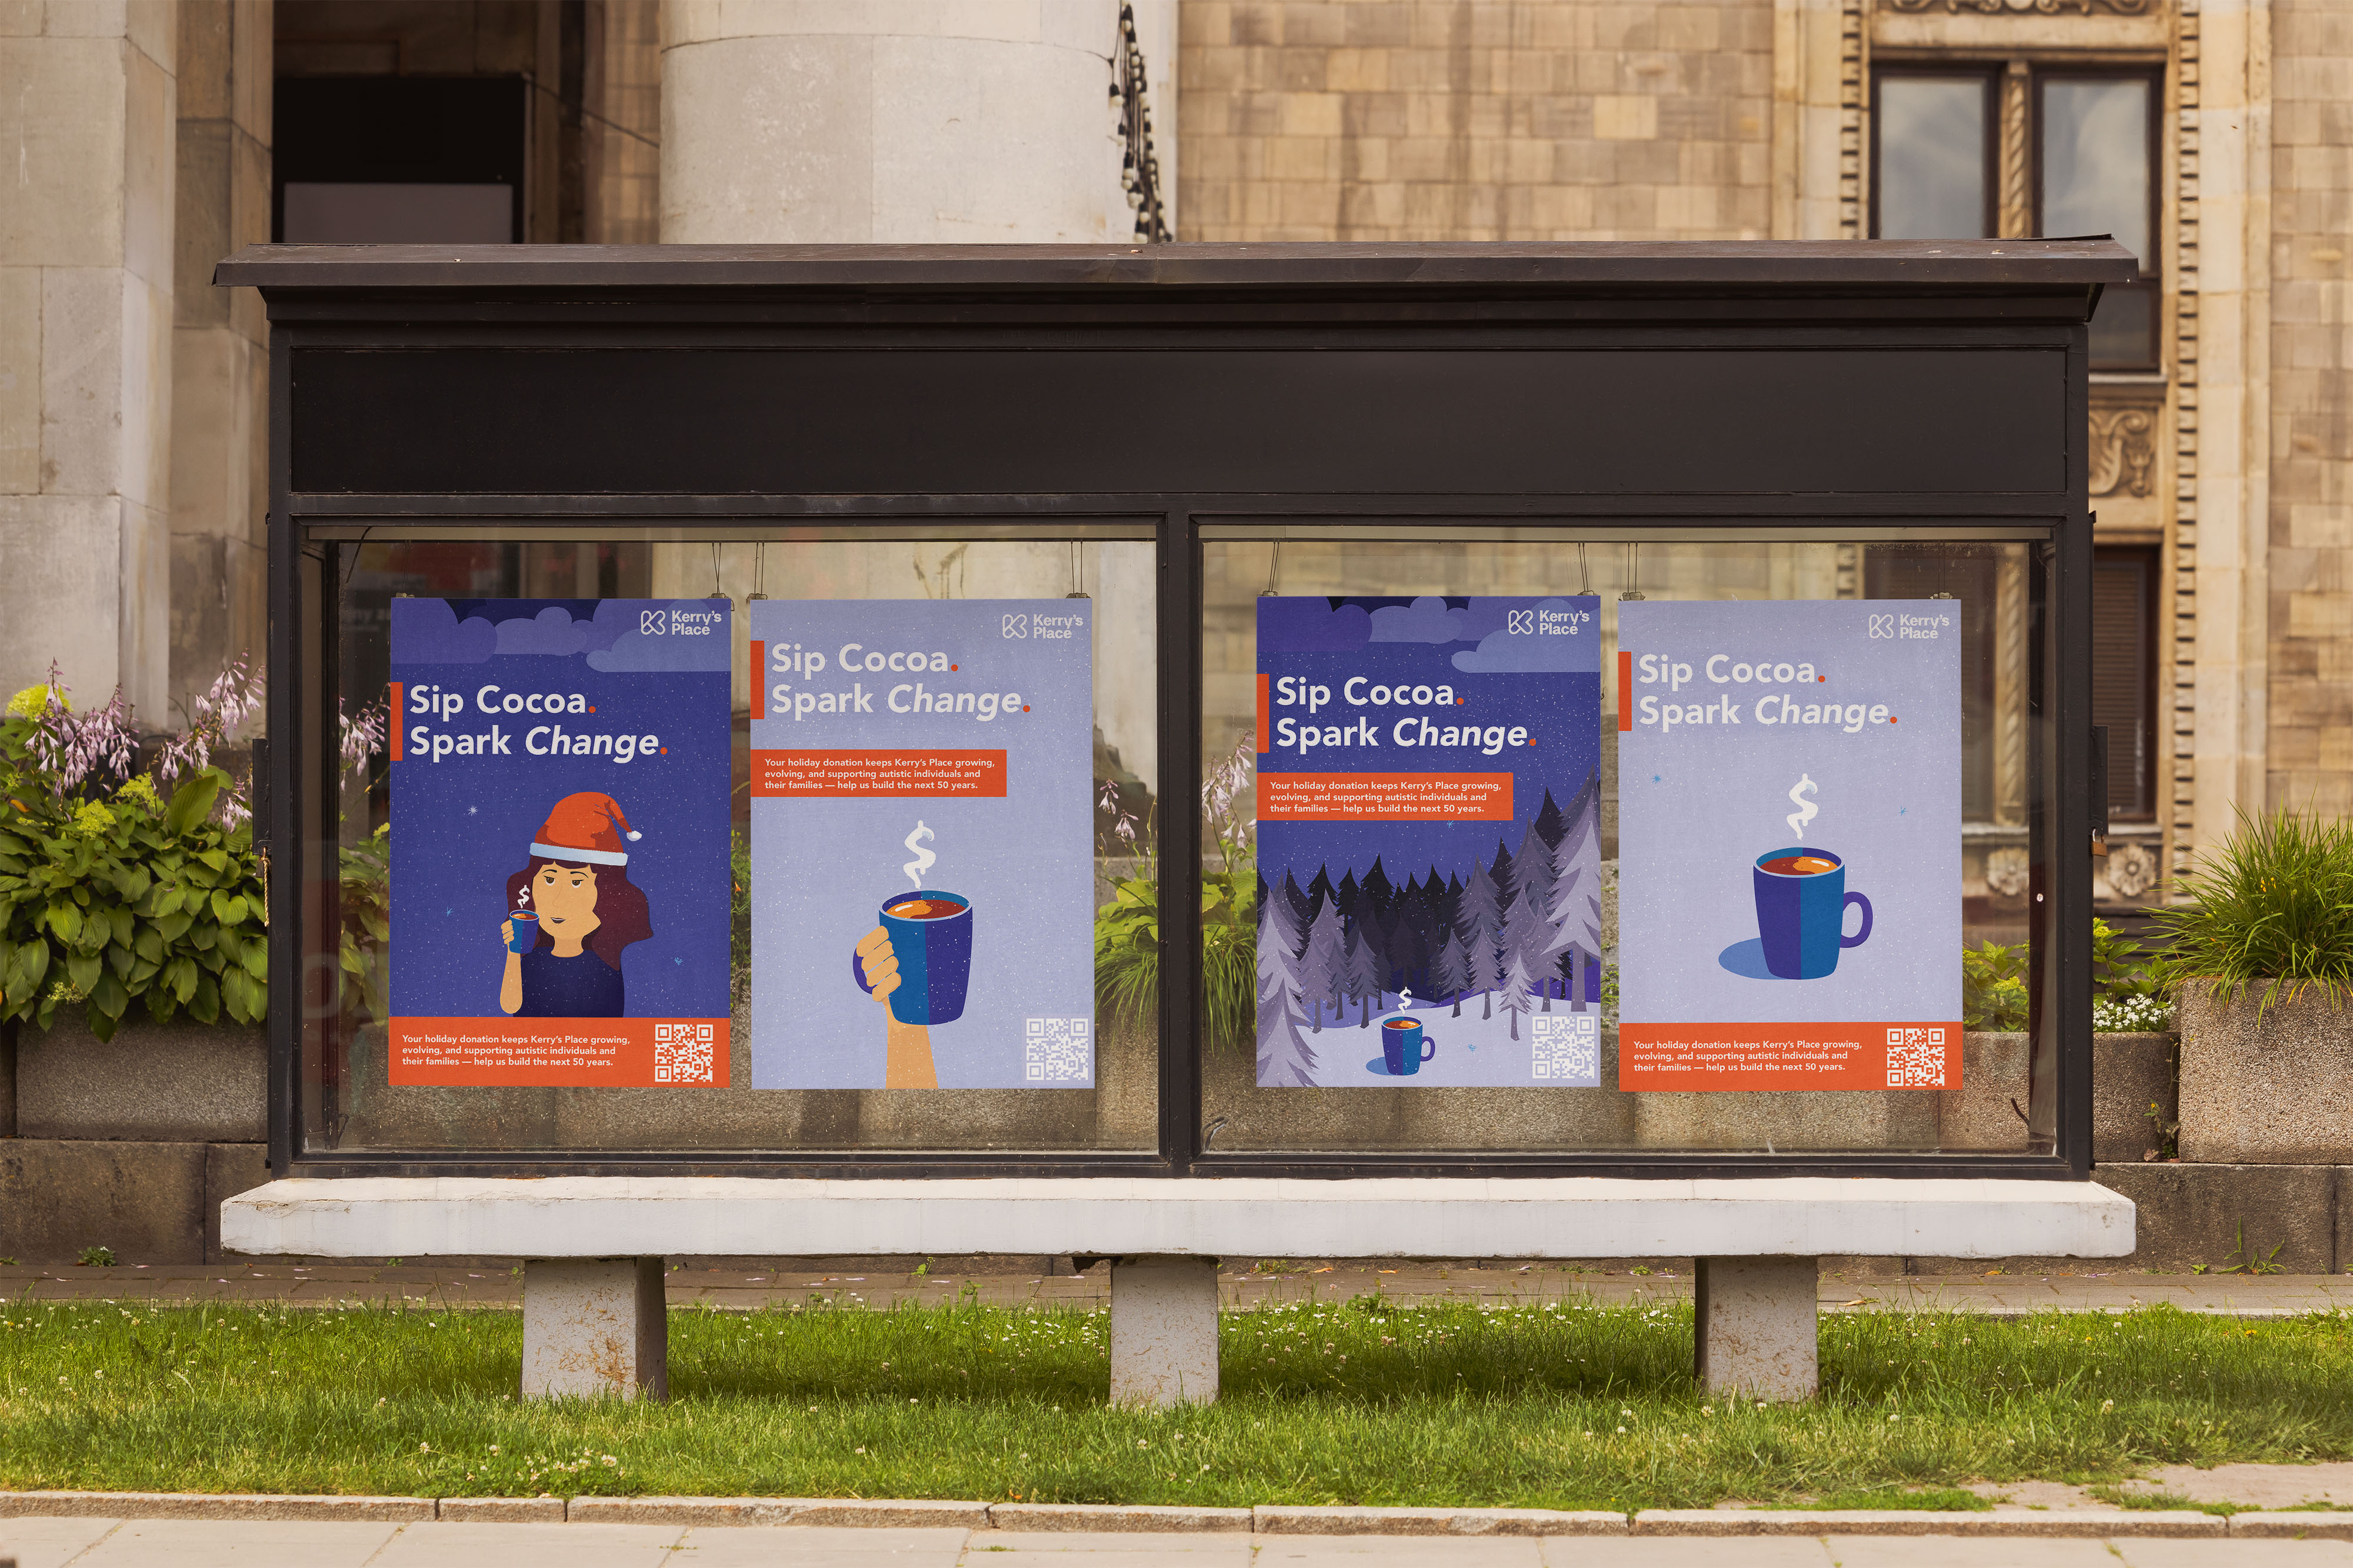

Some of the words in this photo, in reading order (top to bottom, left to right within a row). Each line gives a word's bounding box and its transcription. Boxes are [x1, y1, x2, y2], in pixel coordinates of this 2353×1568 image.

[672, 610, 722, 625] Kerry's
[1034, 614, 1084, 629] Kerry's
[1539, 610, 1589, 625] Kerry's
[1900, 614, 1949, 629] Kerry's
[672, 623, 710, 635] Place
[1034, 627, 1072, 639] Place
[1539, 623, 1578, 635] Place
[1900, 627, 1938, 639] Place
[772, 643, 825, 680] Sip
[839, 643, 958, 672] Cocoa.
[1639, 654, 1693, 692] Sip
[1706, 654, 1825, 683] Cocoa.
[1277, 676, 1331, 713] Sip
[1344, 676, 1464, 706] Cocoa.
[410, 685, 464, 722] Sip
[476, 685, 596, 714] Cocoa.
[772, 683, 874, 721] Spark
[888, 683, 1031, 722] Change.
[1639, 694, 1741, 733] Spark
[1755, 694, 1897, 733] Change.
[1277, 716, 1379, 755] Spark
[1393, 716, 1537, 755] Change.
[410, 725, 512, 763] Spark
[525, 725, 668, 763] Change.
[765, 758, 786, 766] Your
[788, 758, 821, 768] holiday
[823, 758, 863, 766] donation
[865, 758, 892, 768] keeps
[895, 758, 926, 768] Kerry's
[929, 758, 952, 766] Place
[955, 758, 995, 768] growing,
[765, 769, 805, 780] evolving,
[808, 769, 825, 778] and
[828, 770, 876, 780] supporting
[914, 769, 962, 778] individuals
[964, 769, 981, 778] and
[764, 780, 786, 789] their
[788, 780, 823, 789] families
[838, 780, 857, 791] help
[872, 780, 894, 789] build
[896, 780, 912, 789] the
[951, 783, 978, 791] years.
[1293, 781, 1326, 792] holiday
[1328, 781, 1369, 789] donation
[1371, 781, 1398, 792] keeps
[1401, 782, 1432, 792] Kerry's
[1435, 781, 1459, 789] Place
[1461, 782, 1501, 792] growing,
[1270, 792, 1311, 803] evolving,
[1314, 792, 1331, 801] and
[1333, 793, 1382, 803] supporting
[1385, 793, 1418, 801] autistic
[1420, 792, 1468, 801] individuals
[1470, 792, 1487, 801] and
[1270, 804, 1292, 812] their
[1294, 804, 1328, 812] families
[1343, 804, 1363, 815] help
[1378, 804, 1400, 812] build
[1402, 804, 1418, 812] the
[1444, 804, 1455, 812] 50
[1457, 806, 1484, 815] years.
[402, 1035, 423, 1043] Your
[425, 1034, 458, 1045] holiday
[459, 1035, 499, 1043] donation
[502, 1035, 528, 1045] keeps
[531, 1035, 562, 1045] Kerry's
[565, 1035, 588, 1043] Place
[591, 1035, 630, 1045] growing,
[1634, 1041, 1654, 1049] Your
[1657, 1040, 1689, 1051] holiday
[1691, 1040, 1731, 1049] donation
[1734, 1040, 1761, 1051] keeps
[1763, 1040, 1794, 1050] Kerry's
[1797, 1040, 1821, 1049] Place
[1822, 1040, 1862, 1050] growing,
[402, 1045, 442, 1056] evolving,
[445, 1045, 462, 1054] and
[464, 1046, 513, 1056] supporting
[515, 1046, 548, 1055] autistic
[549, 1046, 597, 1055] individuals
[599, 1046, 616, 1055] and
[1634, 1052, 1674, 1062] evolving,
[1677, 1051, 1694, 1060] and
[1696, 1052, 1745, 1062] supporting
[1747, 1051, 1779, 1060] autistic
[1782, 1050, 1829, 1059] individuals
[1831, 1050, 1848, 1059] and
[402, 1056, 424, 1065] their
[425, 1056, 460, 1065] families
[474, 1056, 494, 1067] help
[508, 1057, 531, 1066] build
[532, 1057, 548, 1066] the
[572, 1057, 584, 1066] 50
[1634, 1063, 1655, 1072] their
[1657, 1063, 1692, 1071] families
[1706, 1063, 1725, 1073] help
[1740, 1063, 1762, 1071] build
[1765, 1062, 1780, 1071] the
[1818, 1064, 1845, 1073] years.
